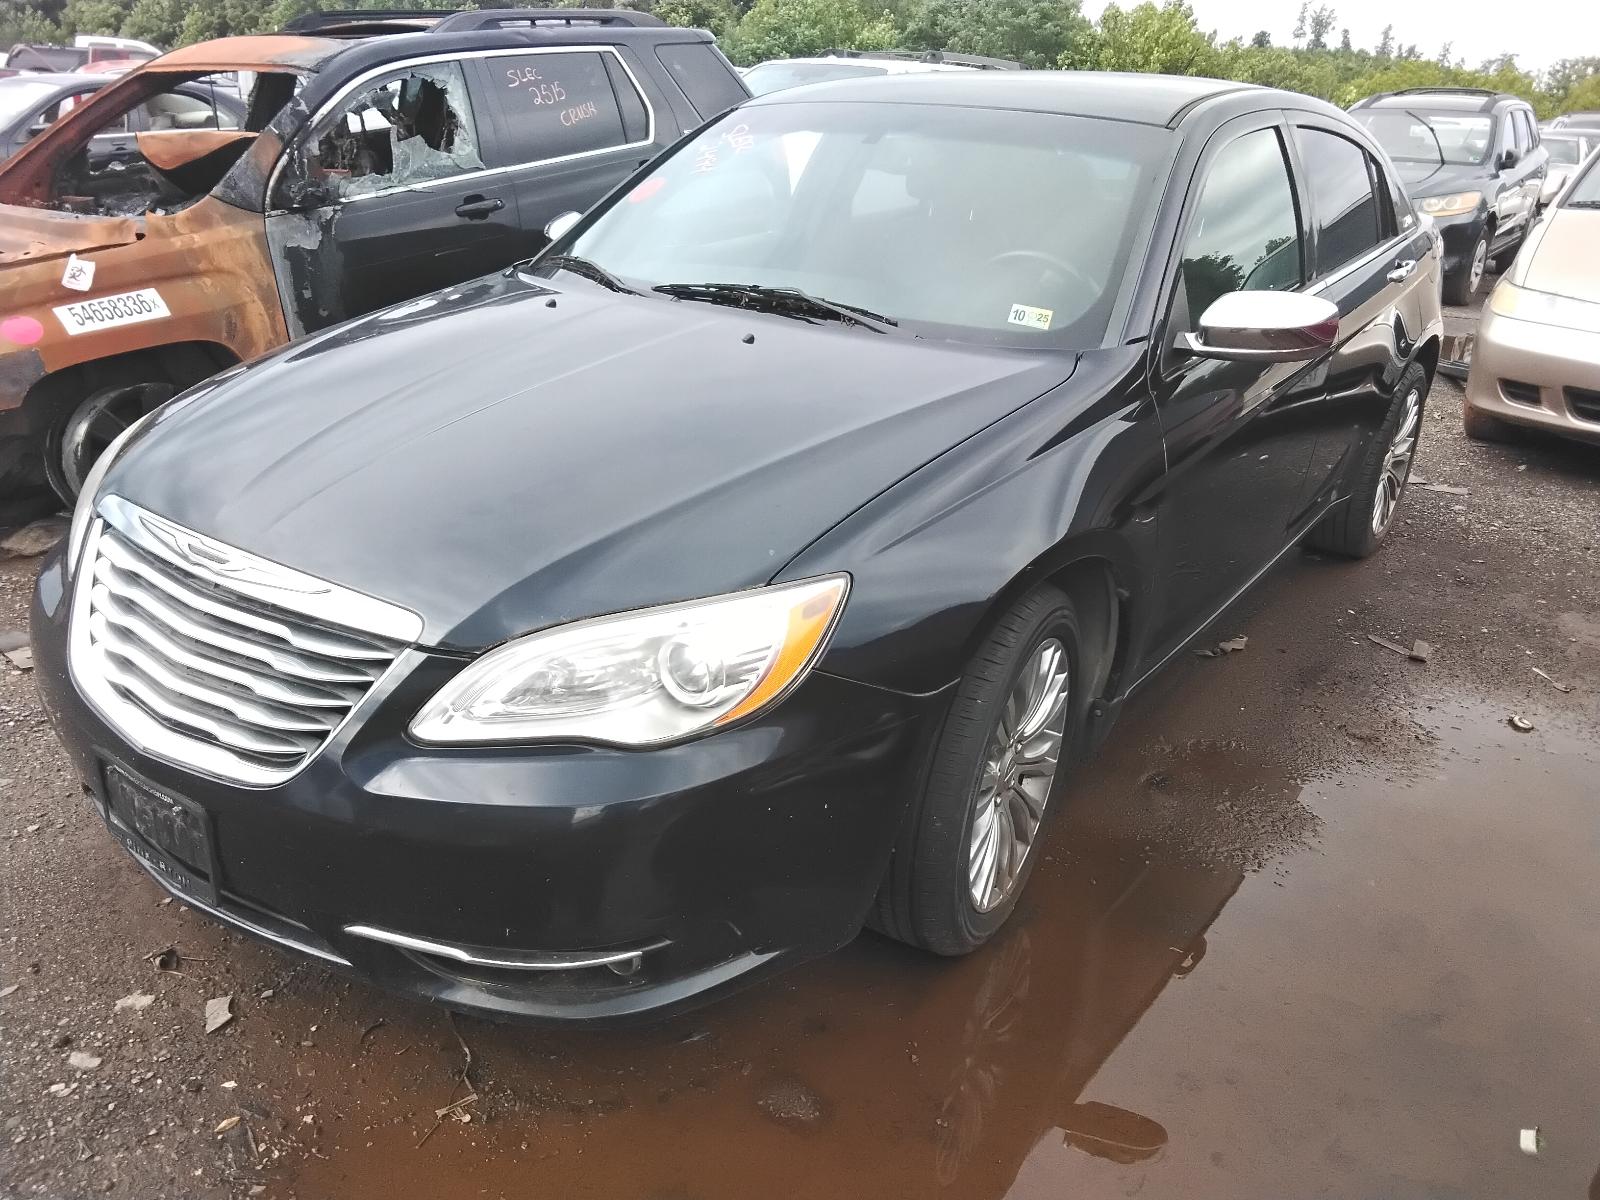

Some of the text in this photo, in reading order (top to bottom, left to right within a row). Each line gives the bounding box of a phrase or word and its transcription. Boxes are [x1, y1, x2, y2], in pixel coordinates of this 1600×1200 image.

[529, 81, 566, 105] 2515
[560, 101, 597, 126] CRUSH
[1013, 309, 1049, 323] 10 25
